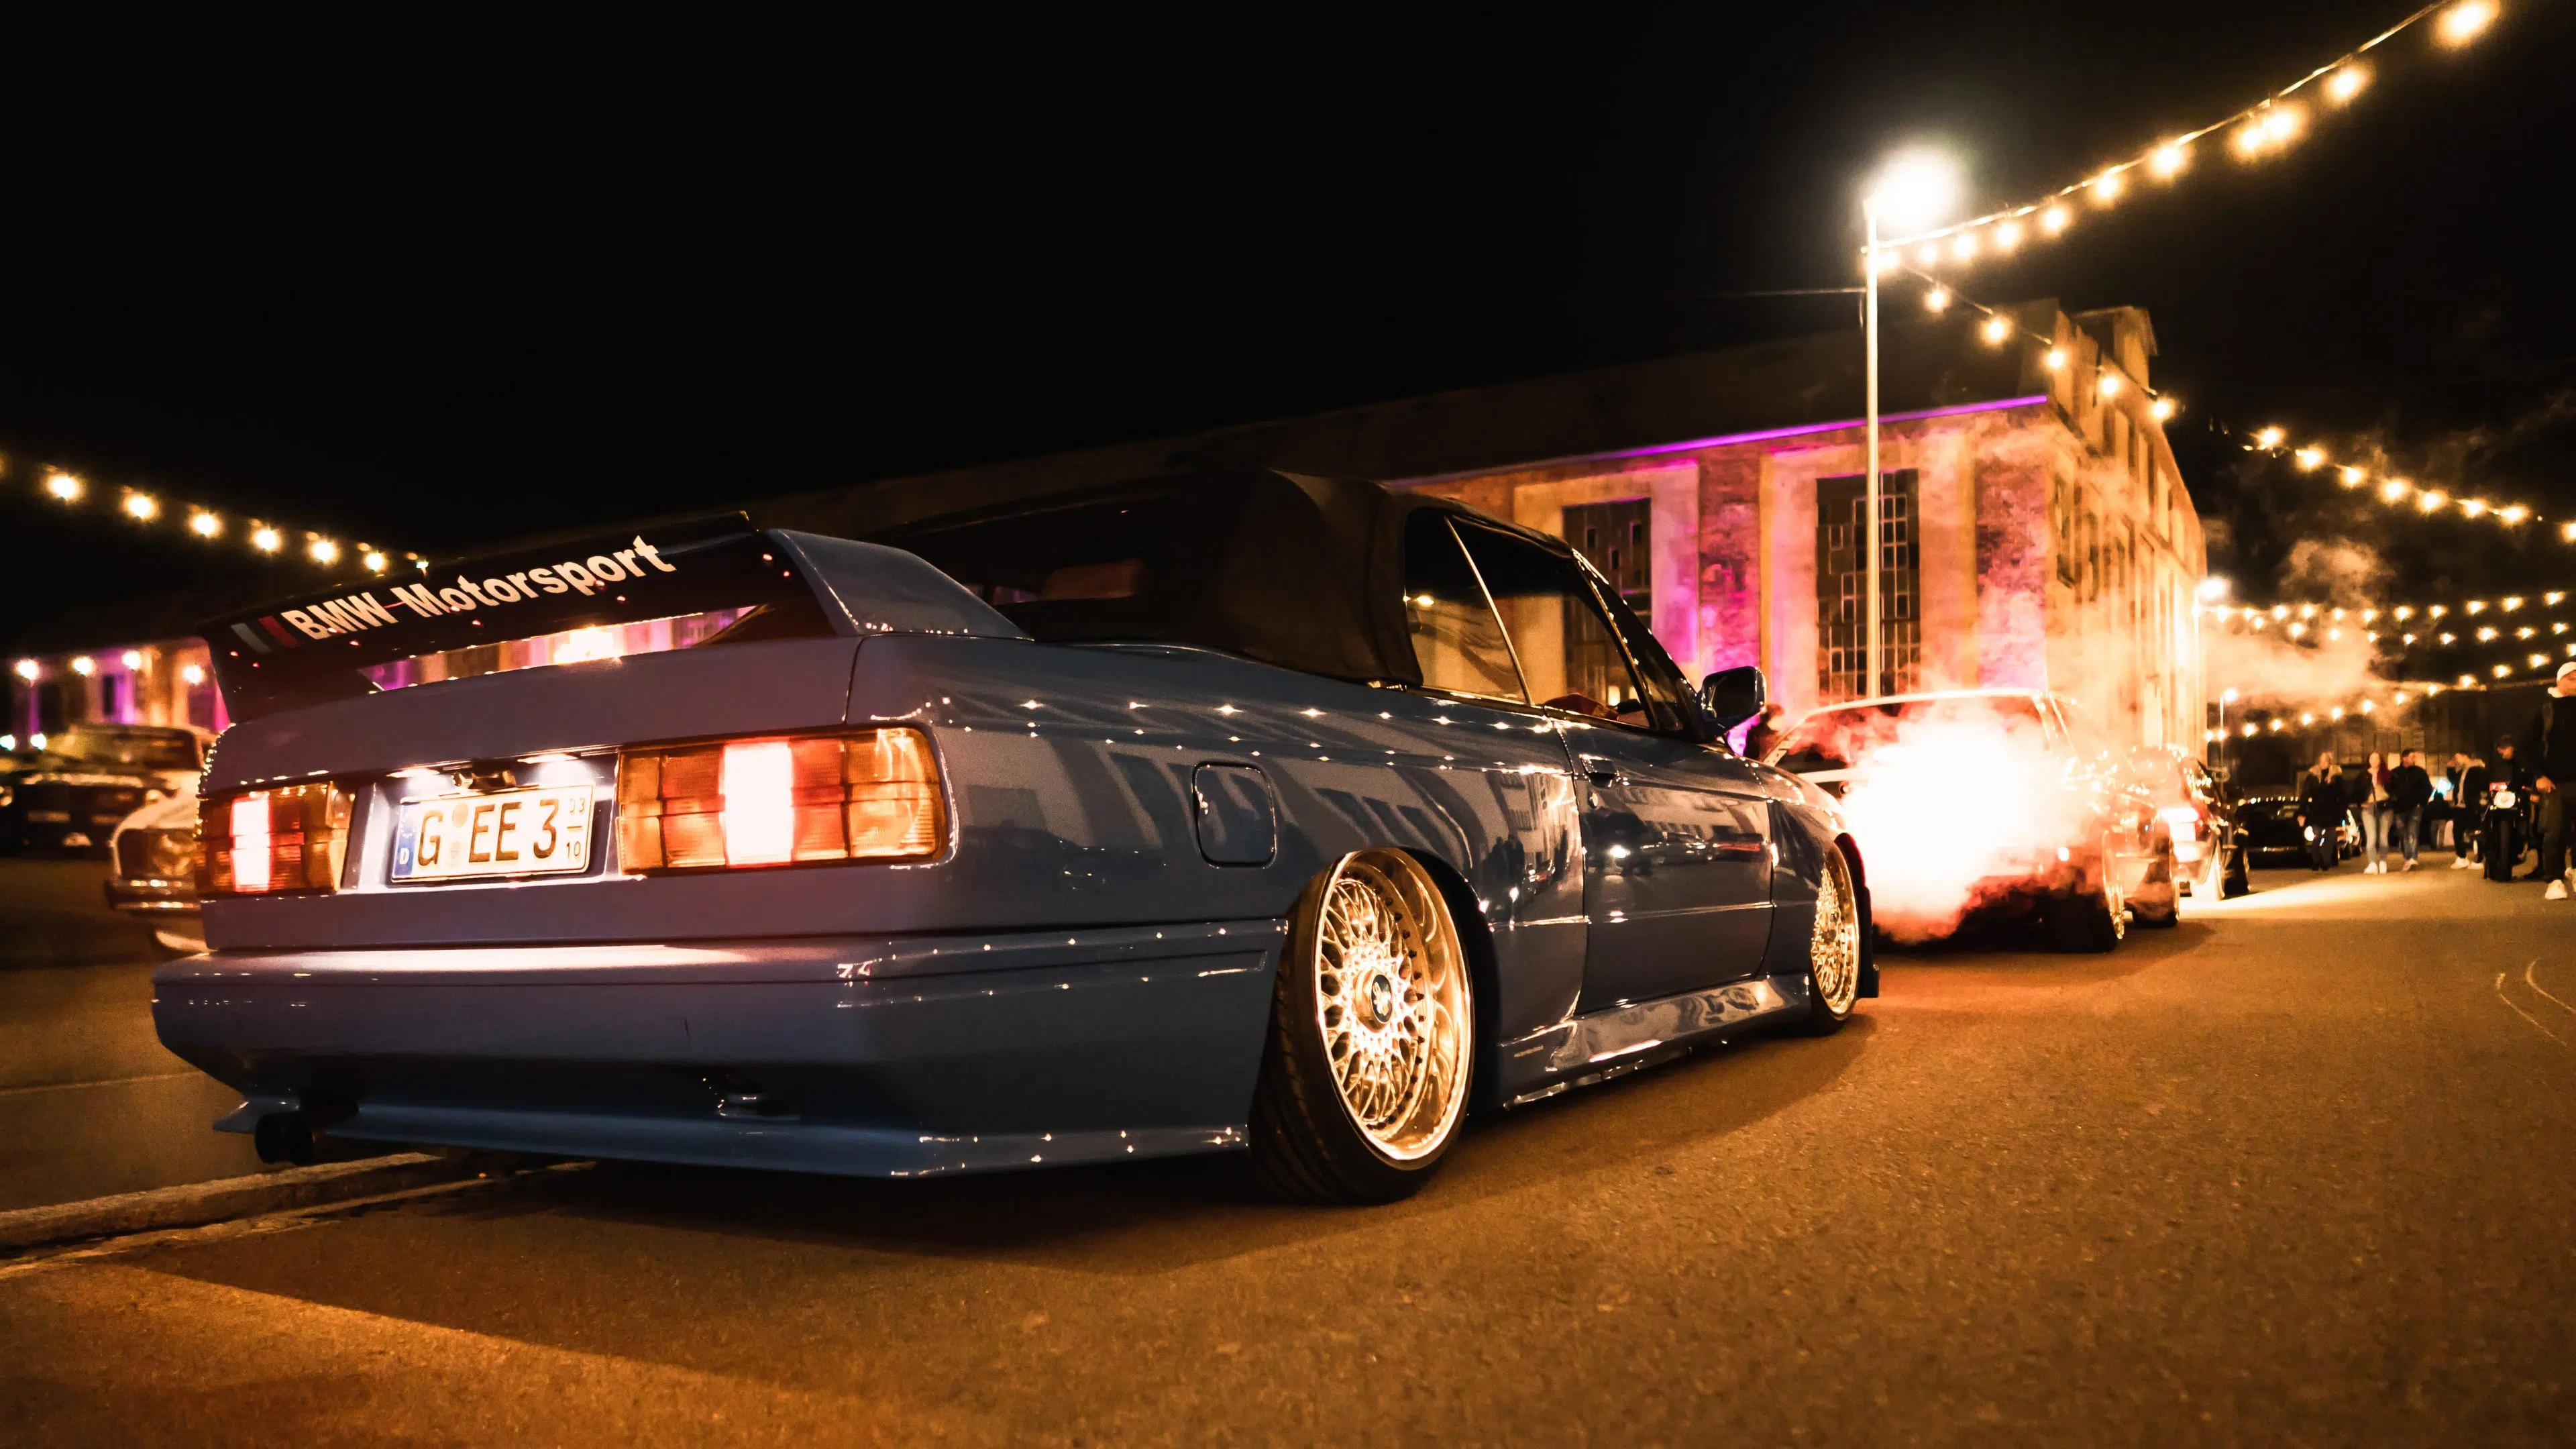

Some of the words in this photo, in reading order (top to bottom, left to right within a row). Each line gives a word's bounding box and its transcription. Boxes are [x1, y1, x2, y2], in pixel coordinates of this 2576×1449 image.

[281, 592, 399, 641] BMW
[390, 535, 678, 618] Motorsport
[398, 847, 410, 865] D
[417, 810, 444, 867] G
[468, 802, 523, 863] EE
[533, 798, 559, 859] 3
[566, 841, 582, 859] 10
